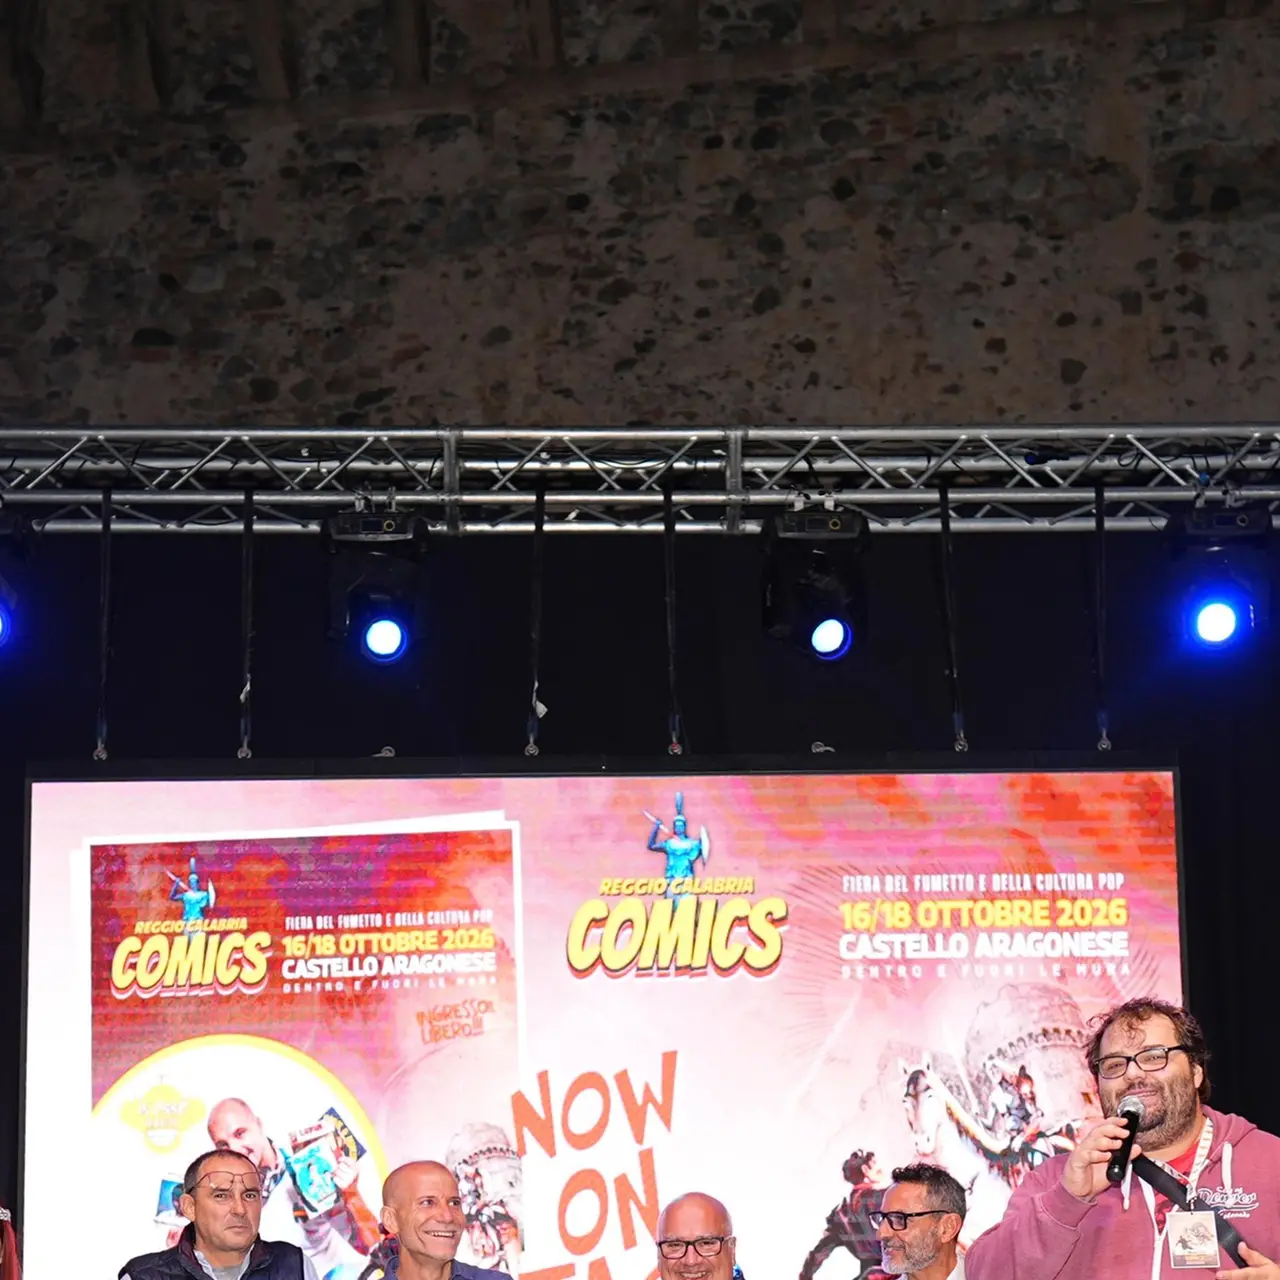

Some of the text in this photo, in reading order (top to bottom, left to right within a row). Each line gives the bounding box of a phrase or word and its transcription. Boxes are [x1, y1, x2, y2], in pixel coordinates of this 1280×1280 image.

[600, 877, 755, 895] REGGIO CALABRIA
[843, 872, 1124, 892] FIERA DEL FUMETTO E DELLA CULTURA POP
[134, 917, 248, 934] REGGIO CALABRIA
[338, 913, 383, 928] FUMETTO
[386, 913, 392, 927] E
[840, 898, 1128, 932] 16/18 OTTOBRE 2026
[282, 927, 495, 959] 16/18 OTTOBRE 2026
[567, 897, 789, 976] COMICS
[840, 931, 1129, 959] CASTELLO ARAGONESE
[111, 931, 272, 995] COMICS
[282, 952, 497, 979] CASTELLO ARAGONESE
[511, 1050, 678, 1159] NOW
[558, 1147, 660, 1257] ON
